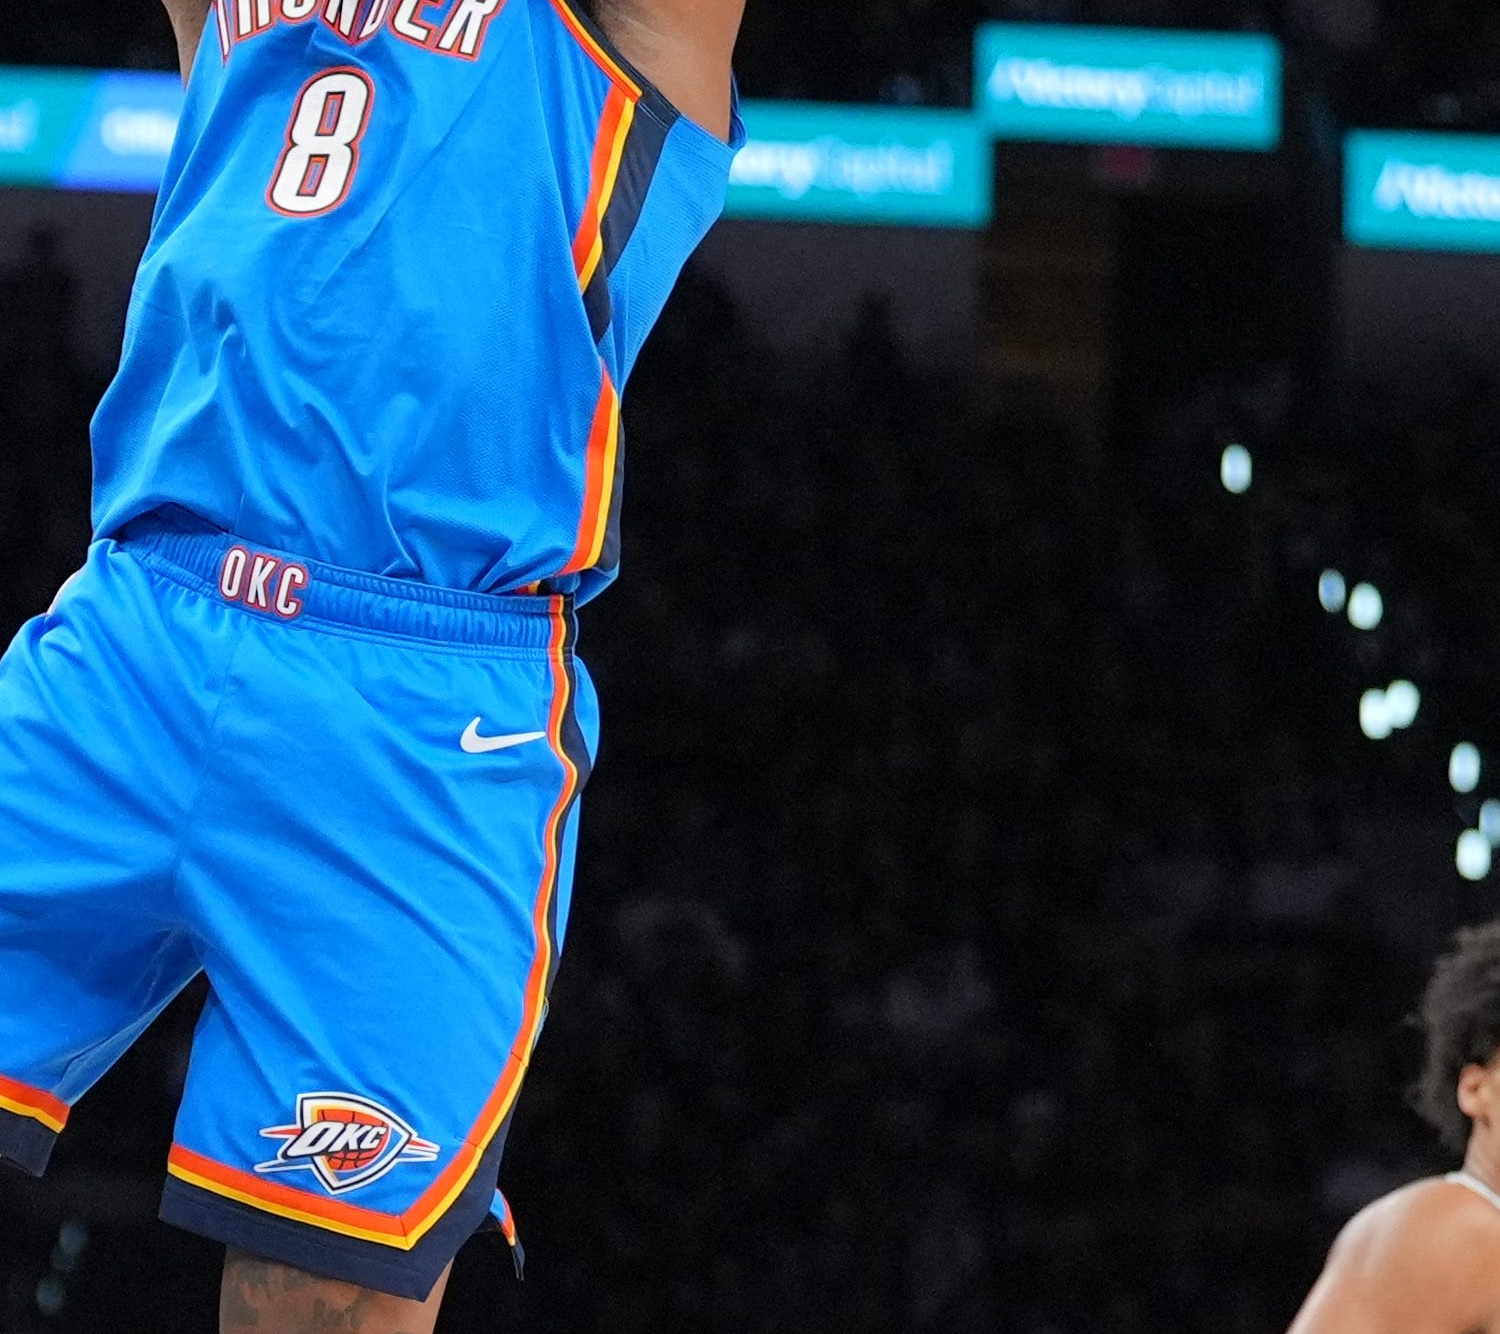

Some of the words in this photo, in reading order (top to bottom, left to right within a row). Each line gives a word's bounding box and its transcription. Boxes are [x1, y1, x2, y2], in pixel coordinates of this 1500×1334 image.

[266, 66, 375, 218] 8
[219, 544, 310, 619] OKC
[283, 1120, 389, 1158] OKC
